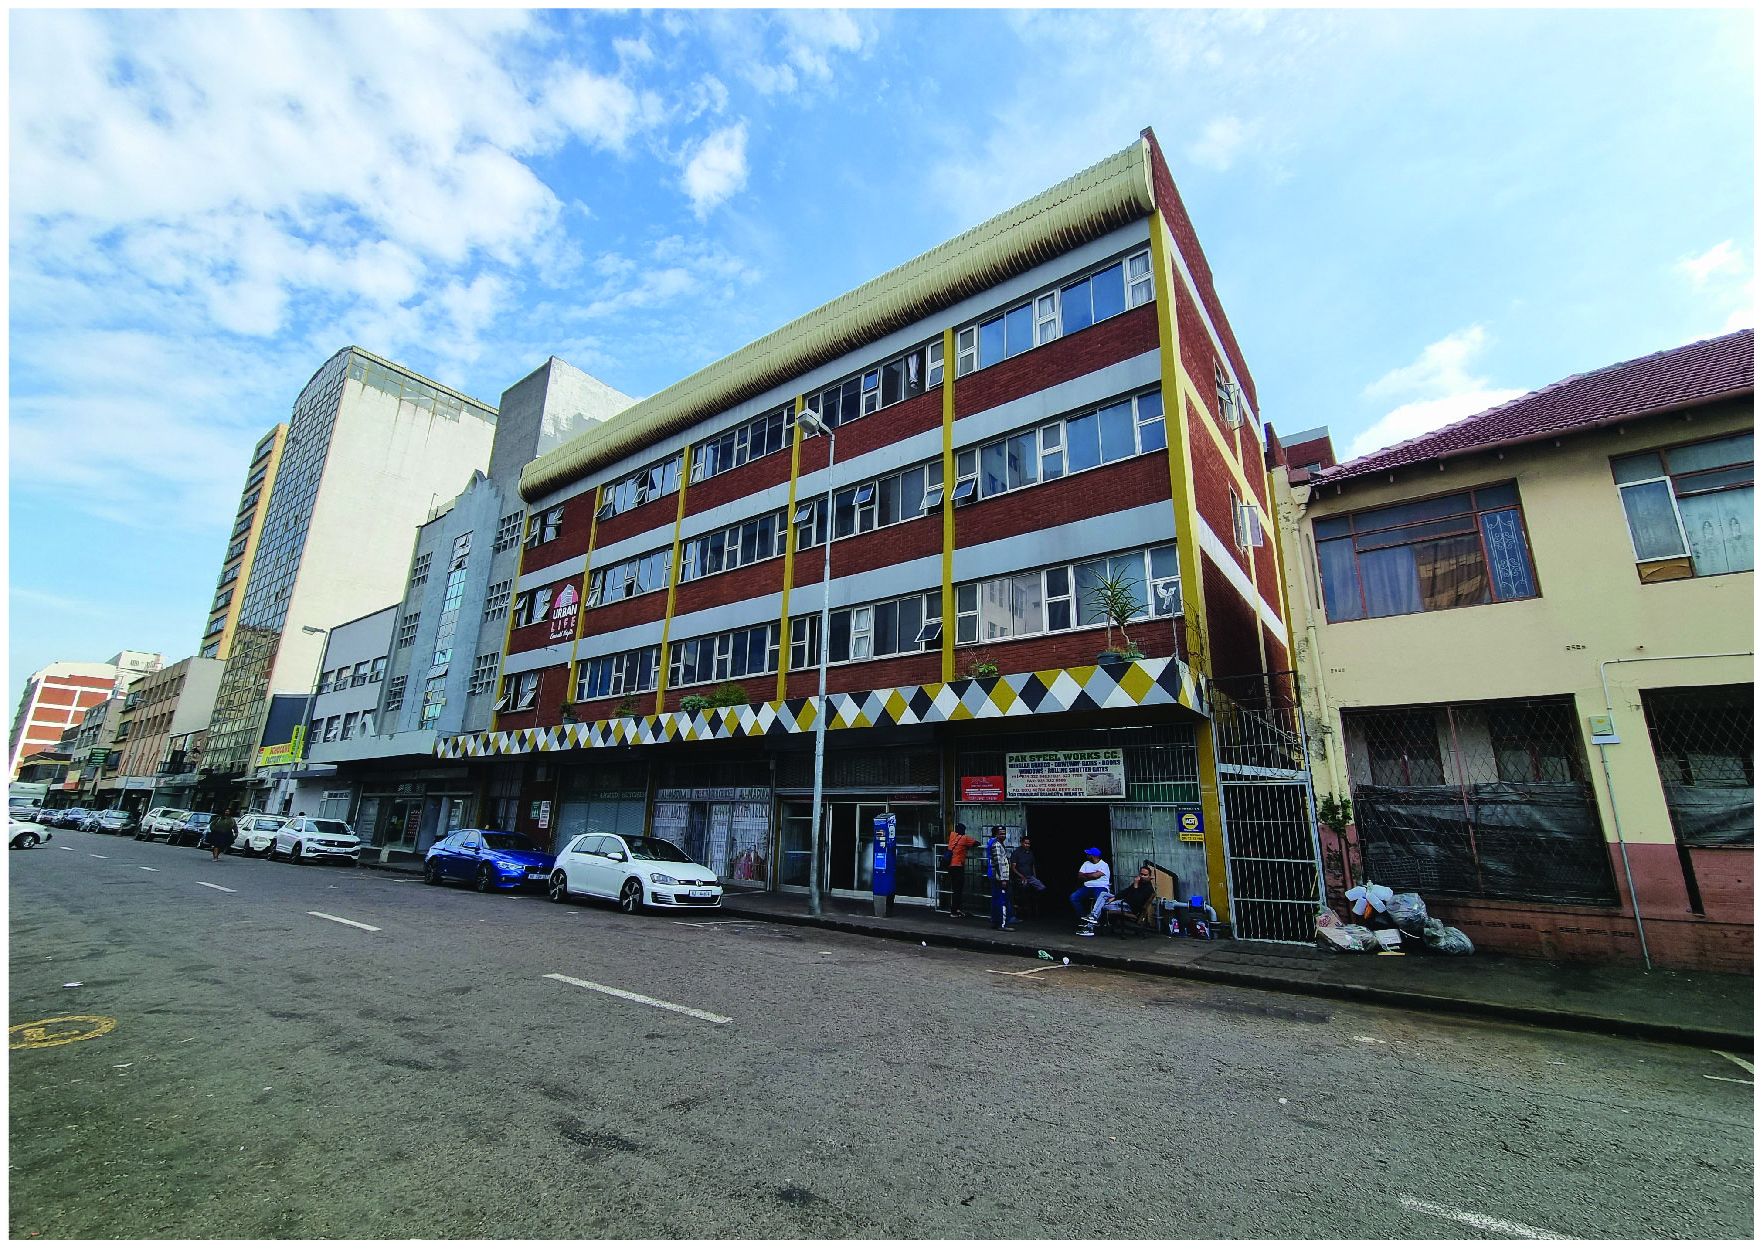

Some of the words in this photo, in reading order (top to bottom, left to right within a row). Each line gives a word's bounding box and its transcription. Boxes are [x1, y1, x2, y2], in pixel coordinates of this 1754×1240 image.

[552, 604, 578, 619] URBAN
[1008, 755, 1026, 763] PAK
[1029, 753, 1061, 762] STEEL
[1062, 752, 1101, 761] WORKS
